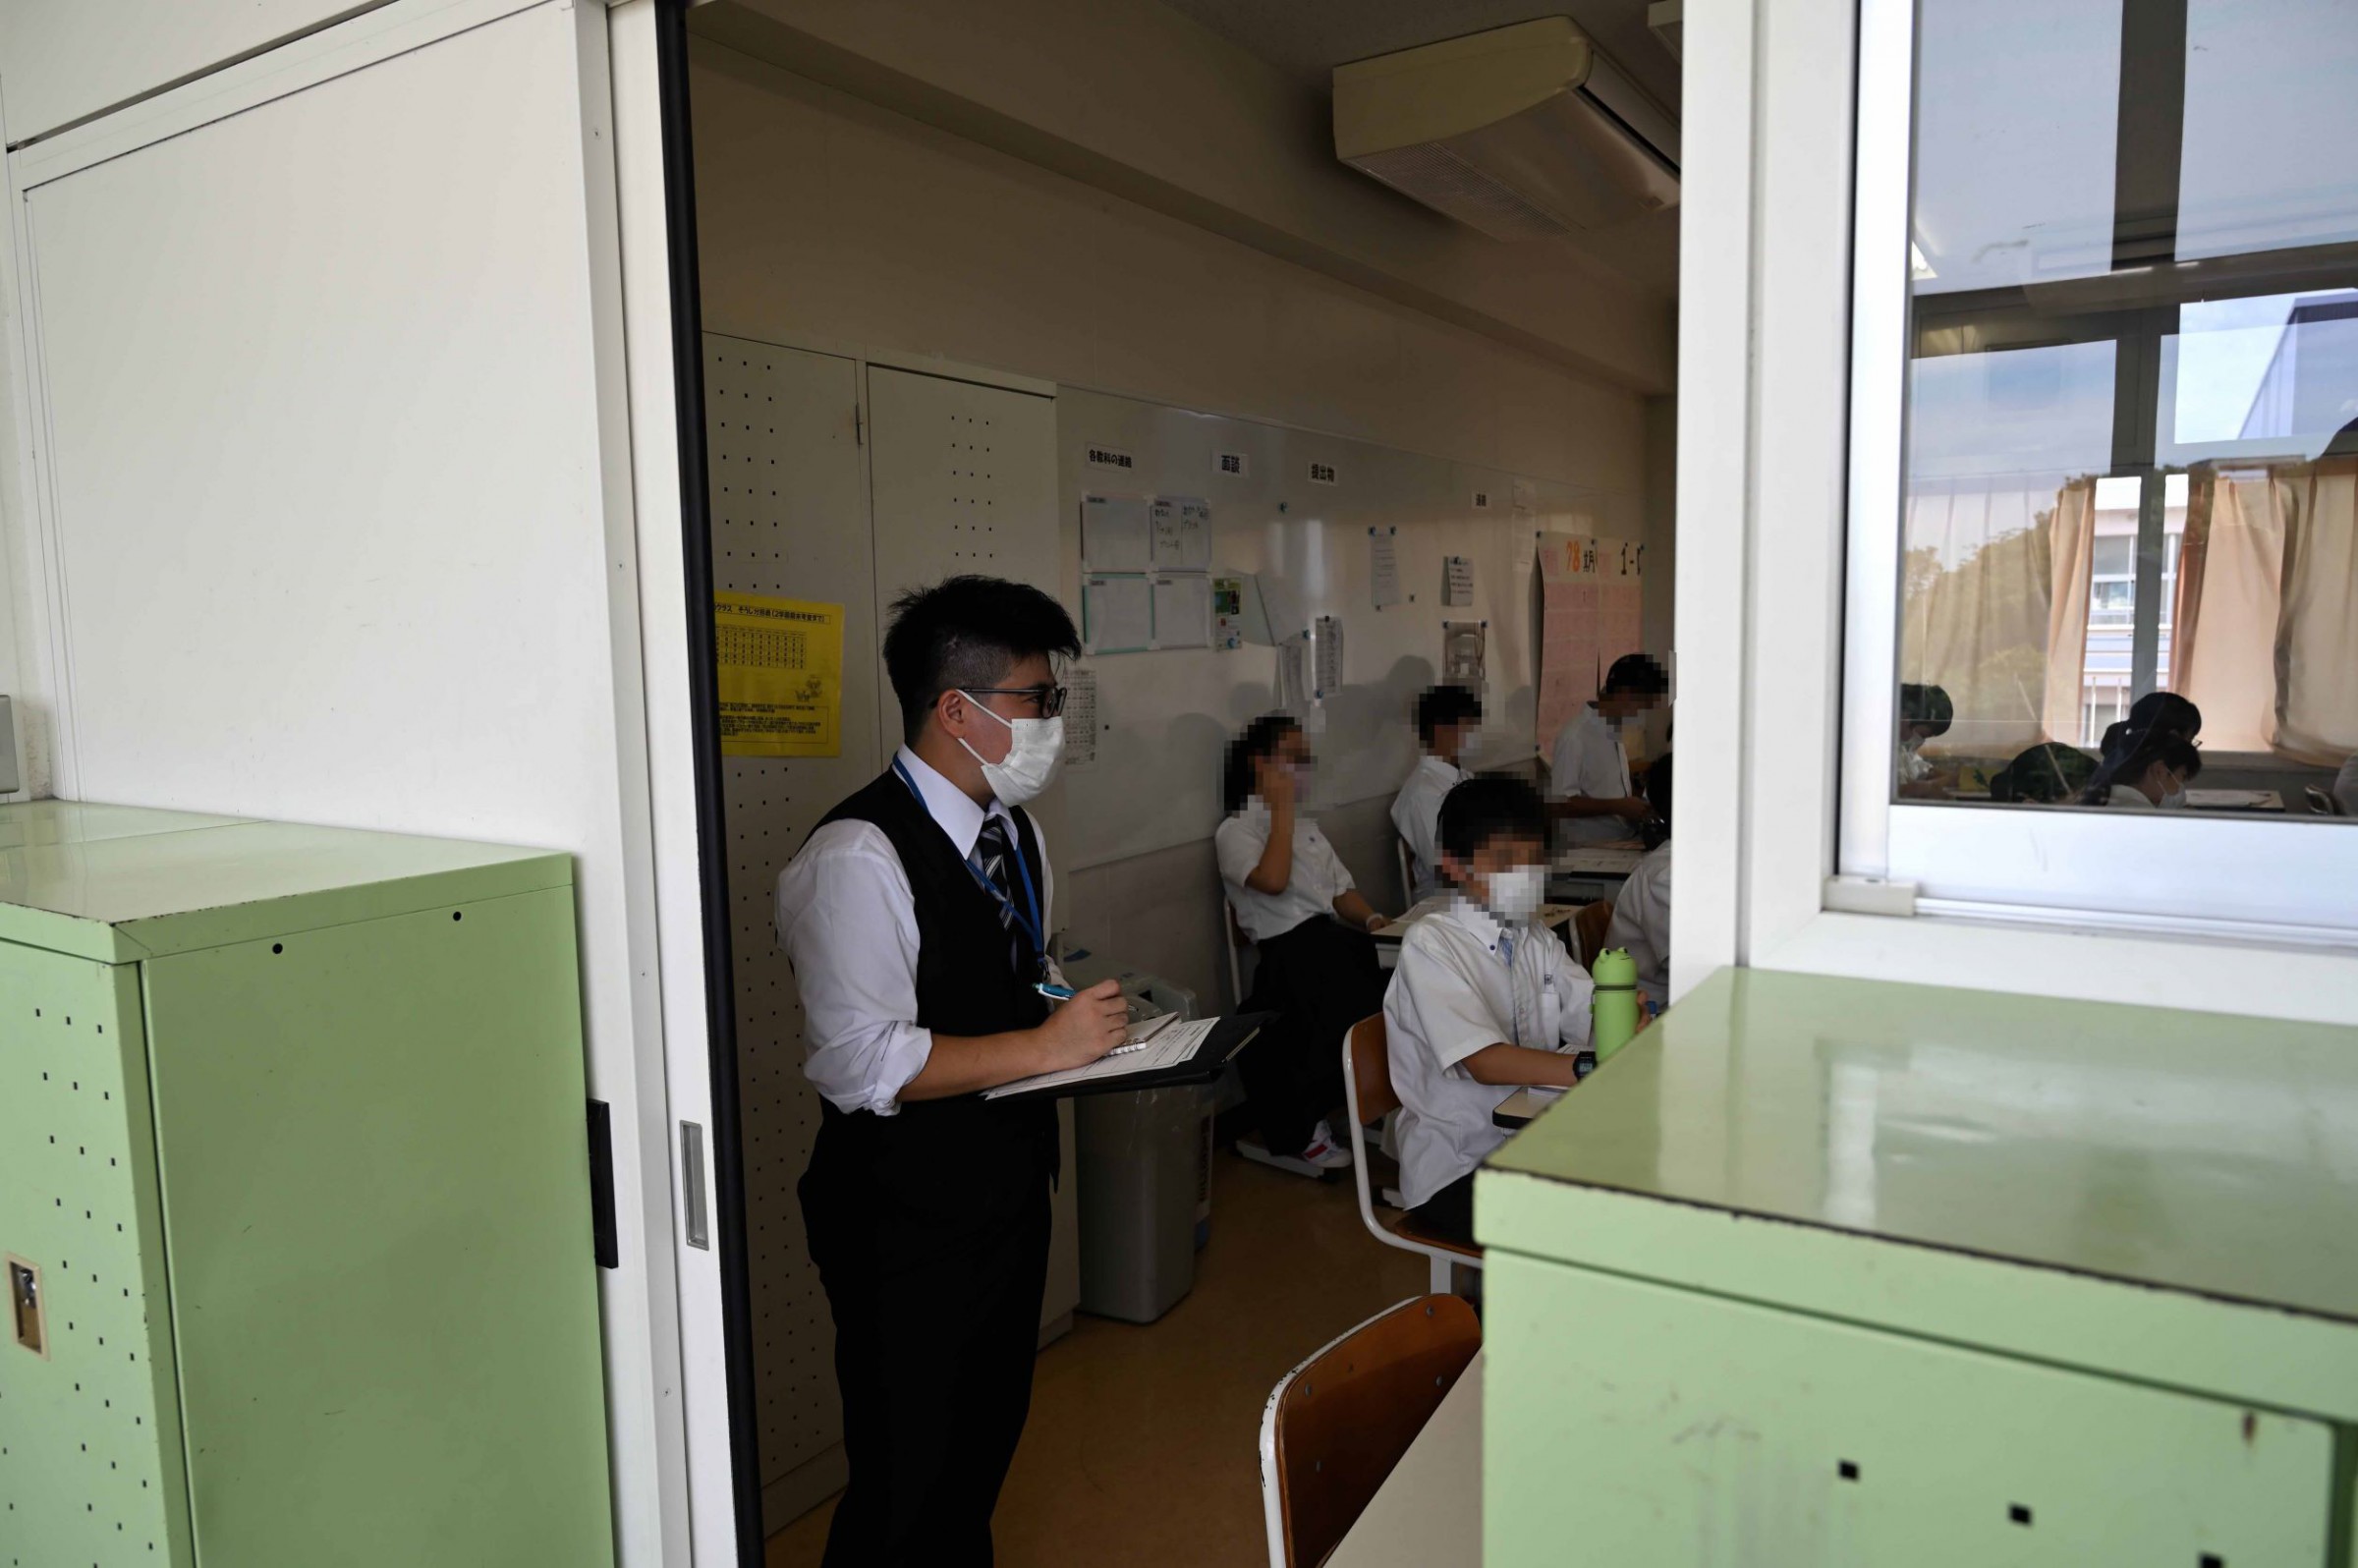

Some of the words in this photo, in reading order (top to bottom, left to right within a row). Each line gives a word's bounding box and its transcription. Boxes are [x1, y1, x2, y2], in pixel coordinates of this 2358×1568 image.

[1089, 449, 1132, 469] 各教科の連絡
[1220, 455, 1240, 475] 面談
[1312, 464, 1334, 482] 提出物
